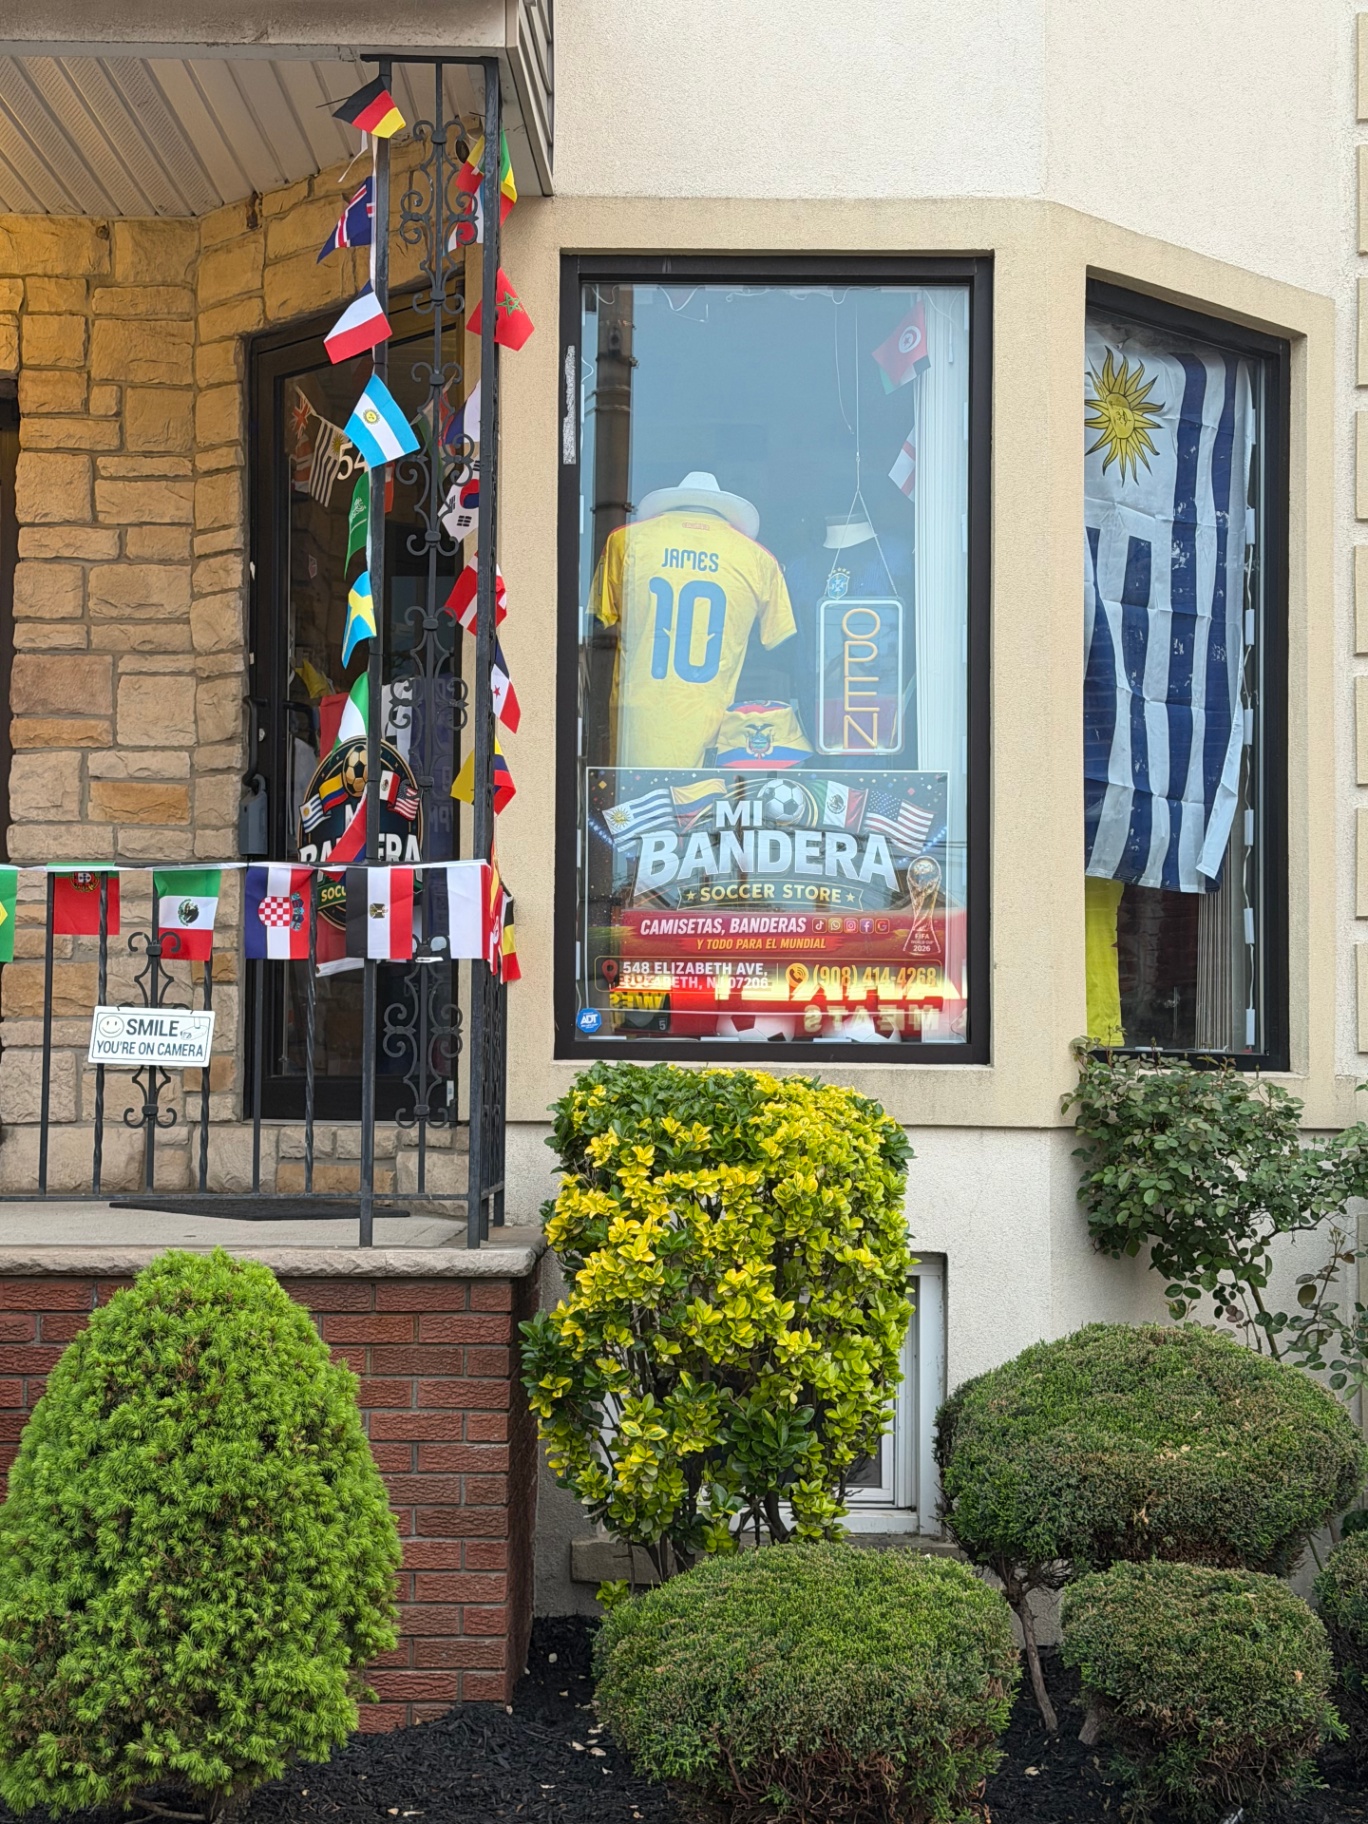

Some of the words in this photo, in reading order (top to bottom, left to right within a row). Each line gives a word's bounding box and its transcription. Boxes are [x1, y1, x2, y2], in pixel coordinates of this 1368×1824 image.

[661, 547, 719, 573] JAMES
[648, 576, 727, 684] 10
[842, 608, 881, 749] OPEN
[715, 800, 763, 827] MI
[634, 829, 900, 897] BANDERA
[700, 883, 775, 901] SOCCER
[782, 883, 842, 903] STORE
[640, 918, 726, 936] CAMISETAS,
[729, 917, 807, 934] BANDERAS
[696, 940, 703, 950] Y
[707, 939, 733, 950] TODO
[736, 939, 762, 949] PARA
[765, 939, 777, 949] EL
[780, 938, 826, 949] MUNDIAL
[623, 961, 650, 974] 548
[654, 961, 731, 975] ELIZABETH
[736, 962, 768, 977] AVE,
[813, 964, 858, 987] (908)
[862, 966, 937, 988] 414-4268
[729, 976, 768, 989] 07206
[126, 1018, 179, 1037] SMILE
[580, 1013, 598, 1025] ADT
[97, 1040, 136, 1055] YOU'RE
[138, 1041, 155, 1055] ON
[157, 1042, 203, 1057] CAMERA
